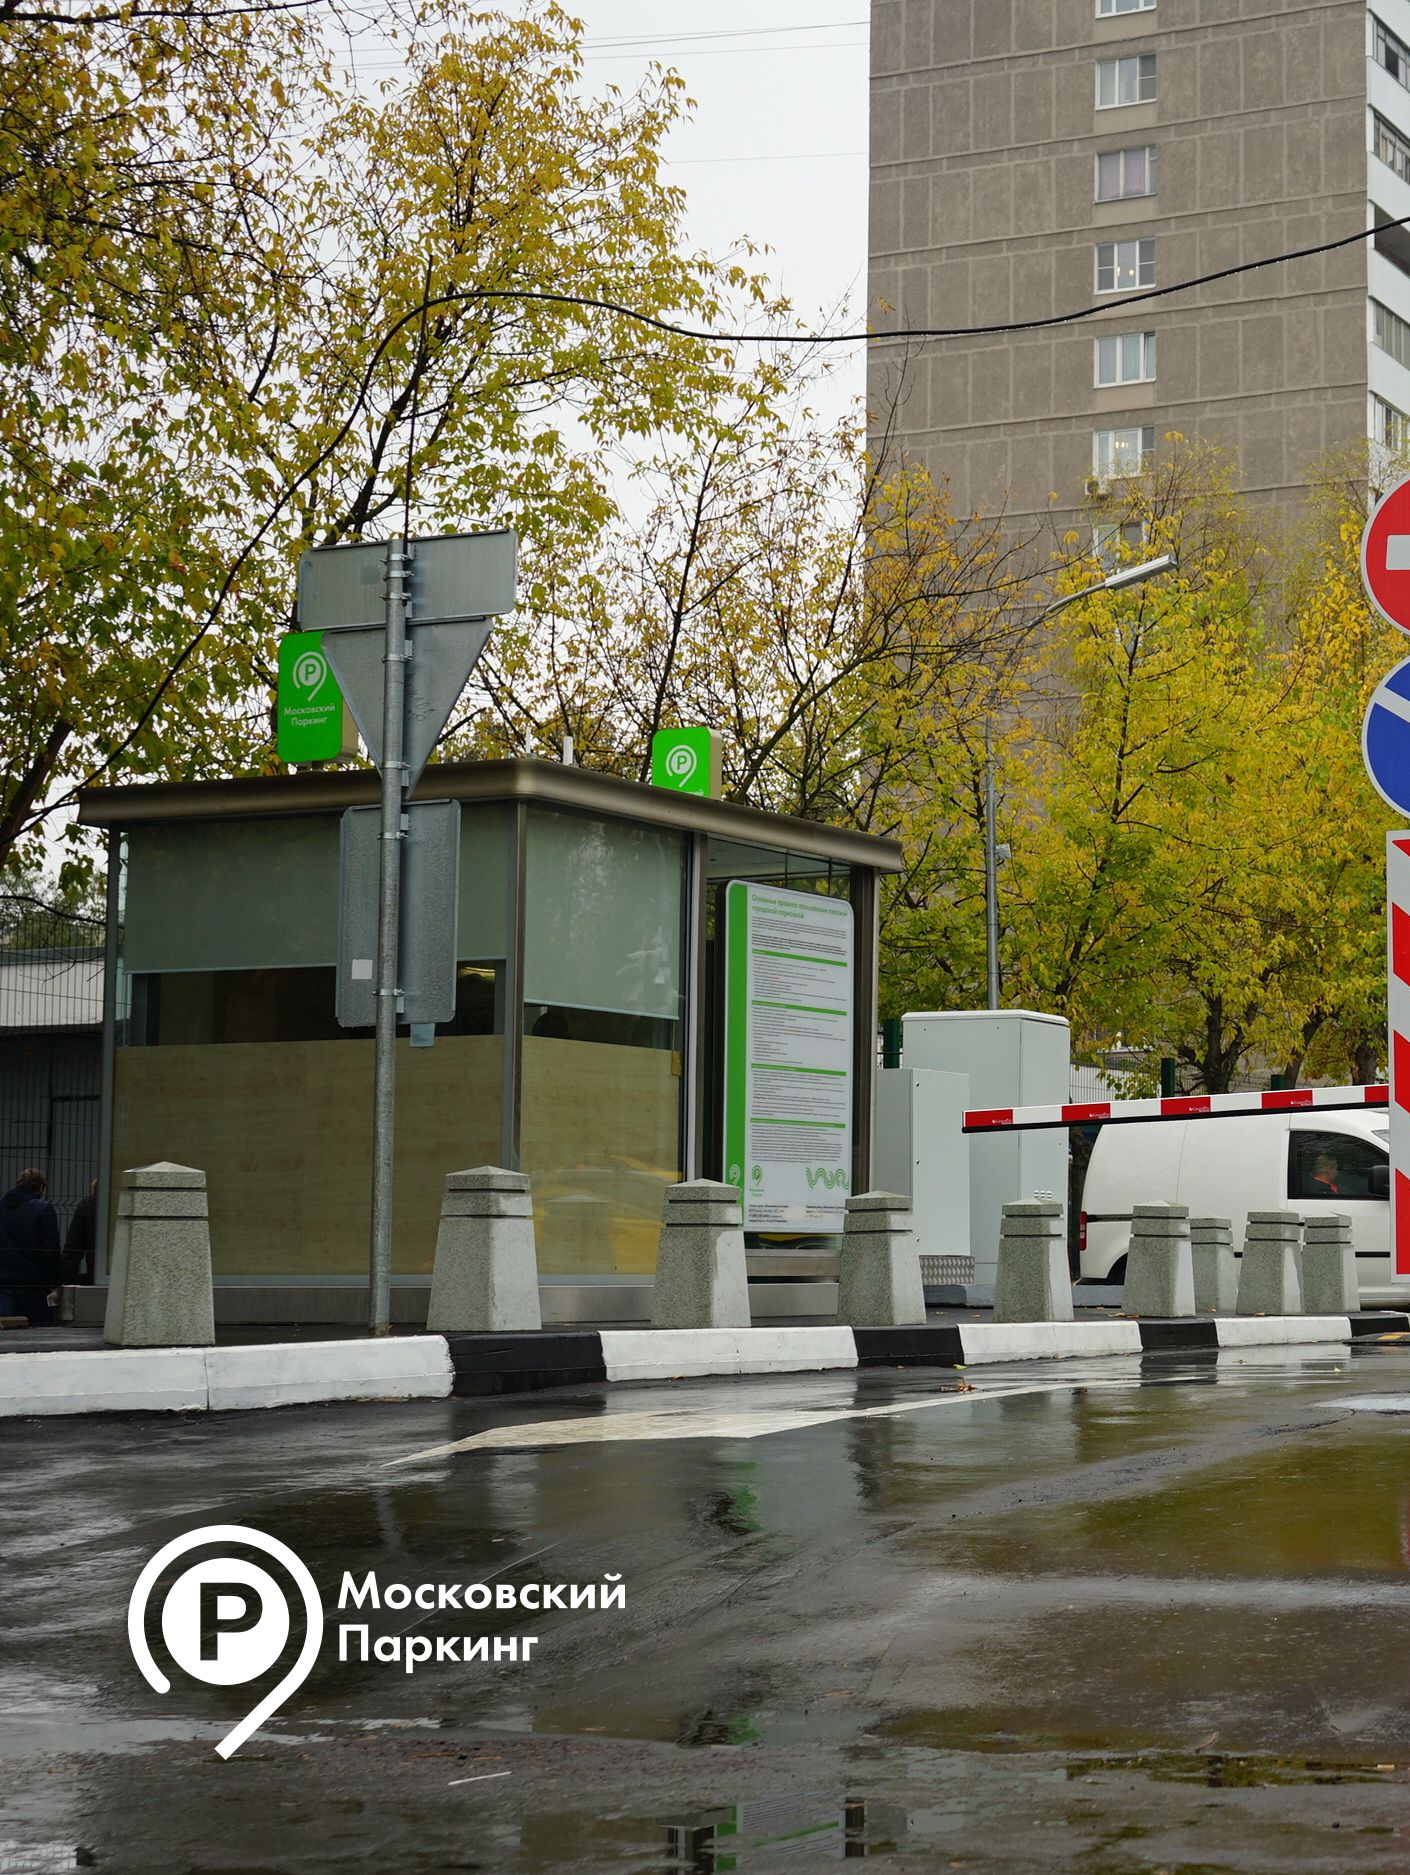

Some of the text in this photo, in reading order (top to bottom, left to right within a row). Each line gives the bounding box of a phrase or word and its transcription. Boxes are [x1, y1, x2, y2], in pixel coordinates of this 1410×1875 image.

[304, 664, 316, 681] P
[284, 704, 335, 716] Московский
[291, 718, 327, 727] Паркинг
[677, 755, 687, 770] P
